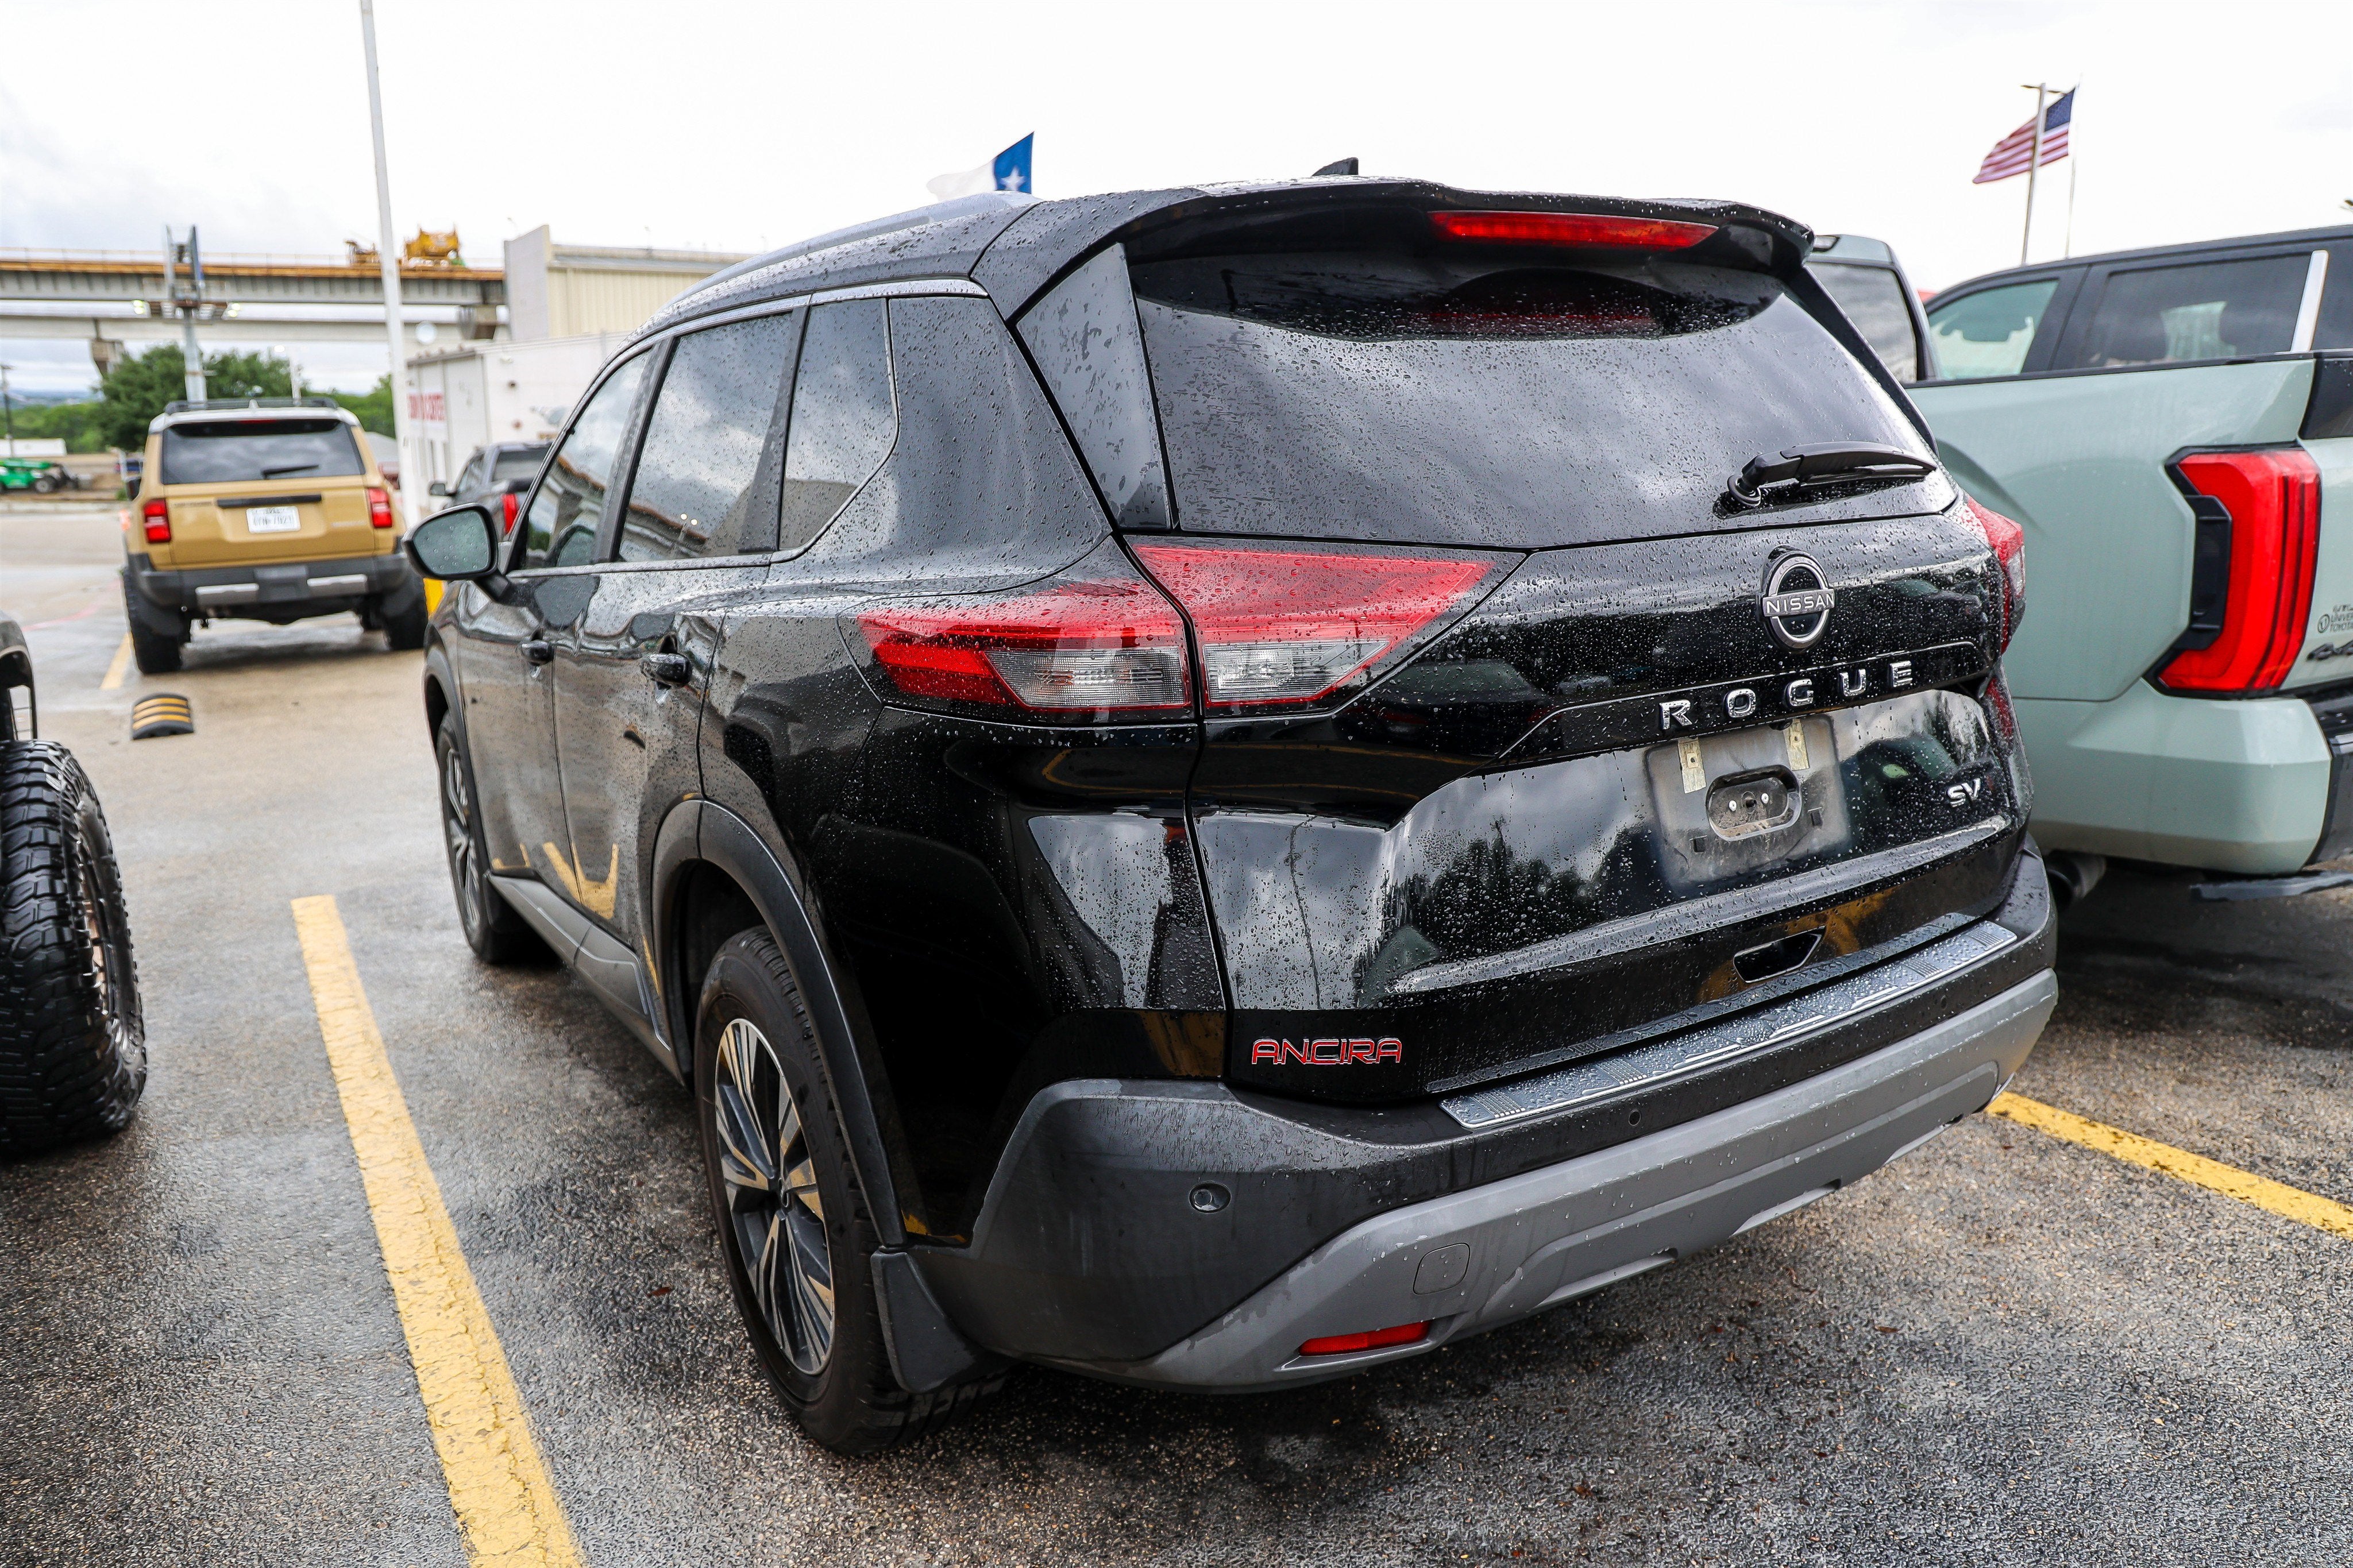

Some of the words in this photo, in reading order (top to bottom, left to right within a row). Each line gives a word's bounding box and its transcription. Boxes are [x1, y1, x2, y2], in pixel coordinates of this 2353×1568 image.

[1766, 593, 1834, 614] NISSAN
[1658, 660, 1913, 730] ROGUE
[1947, 778, 1981, 808] SV
[1251, 1038, 1402, 1065] ANCIRA
